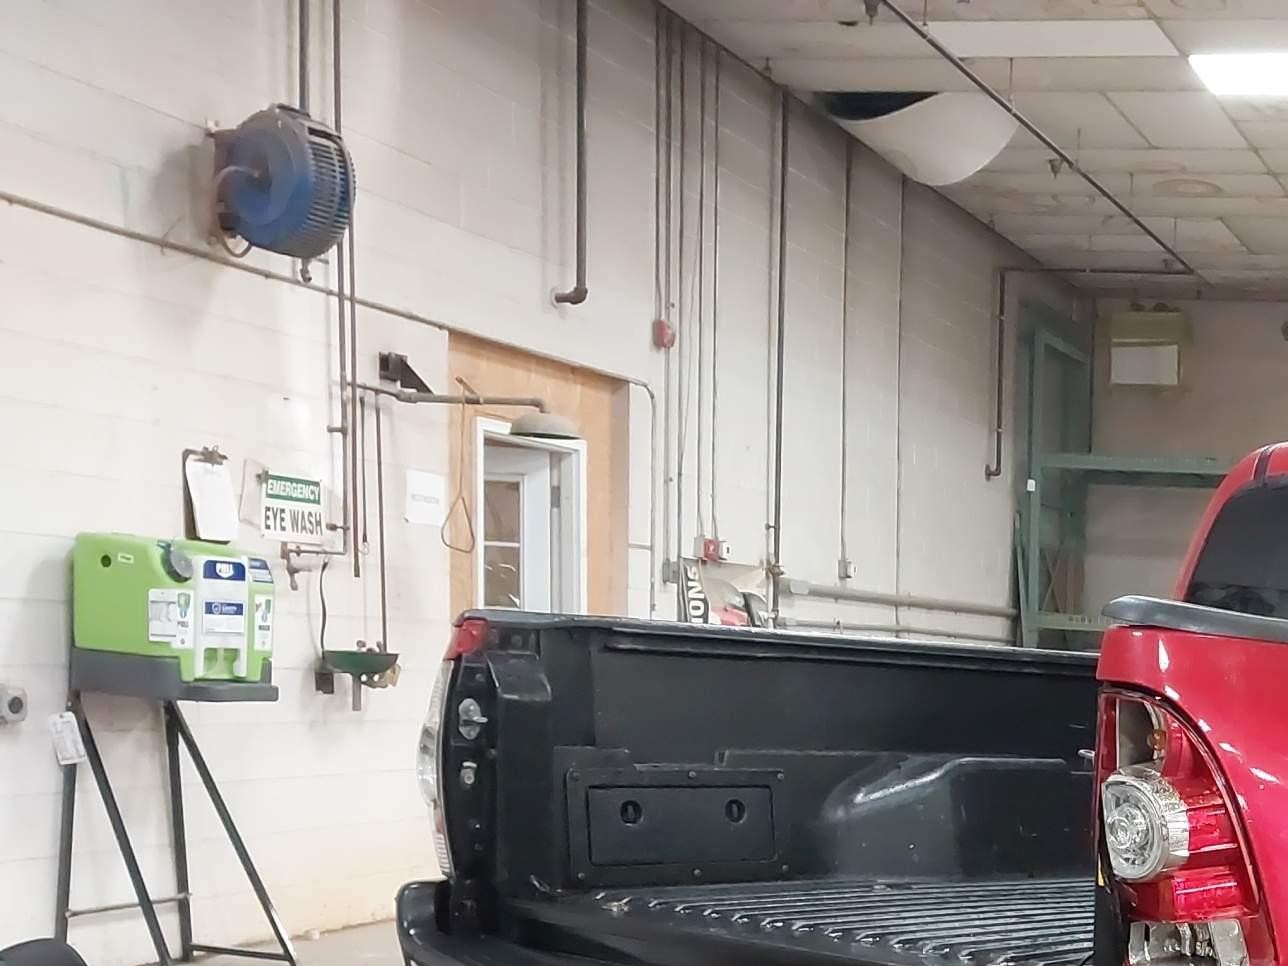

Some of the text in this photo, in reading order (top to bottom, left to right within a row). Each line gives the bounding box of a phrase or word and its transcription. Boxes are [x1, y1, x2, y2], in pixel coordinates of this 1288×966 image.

[267, 479, 320, 501] EMERGENCY
[264, 506, 323, 536] EYE WASH
